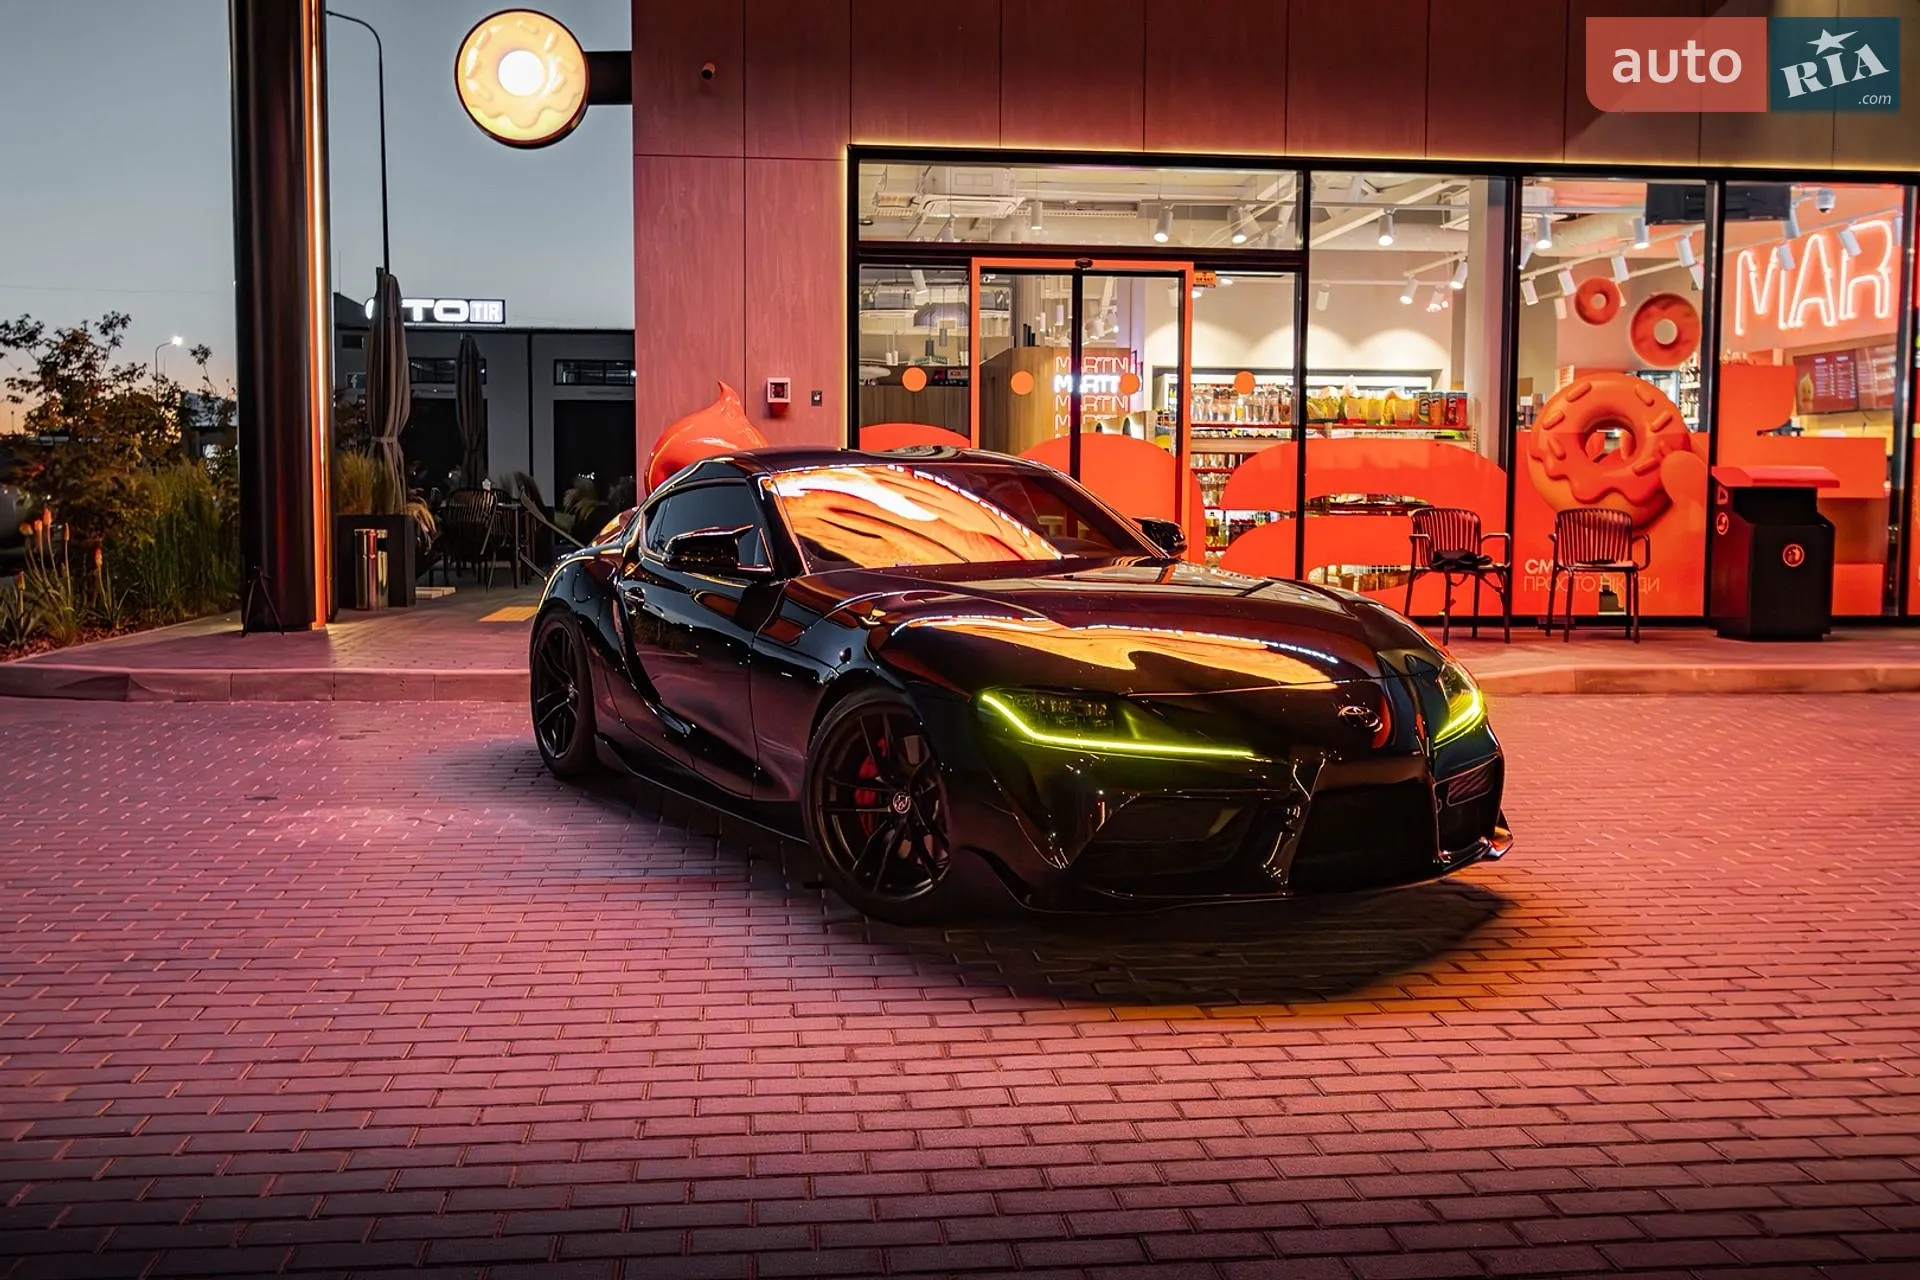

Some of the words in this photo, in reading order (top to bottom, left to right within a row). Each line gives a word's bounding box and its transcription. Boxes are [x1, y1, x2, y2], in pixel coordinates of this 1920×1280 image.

[1735, 220, 1892, 336] MAR
[364, 298, 470, 322] ТО
[1055, 356, 1129, 373] MRTIN
[1055, 395, 1129, 412] MRTIN
[1599, 575, 1660, 594] НІКДИ
